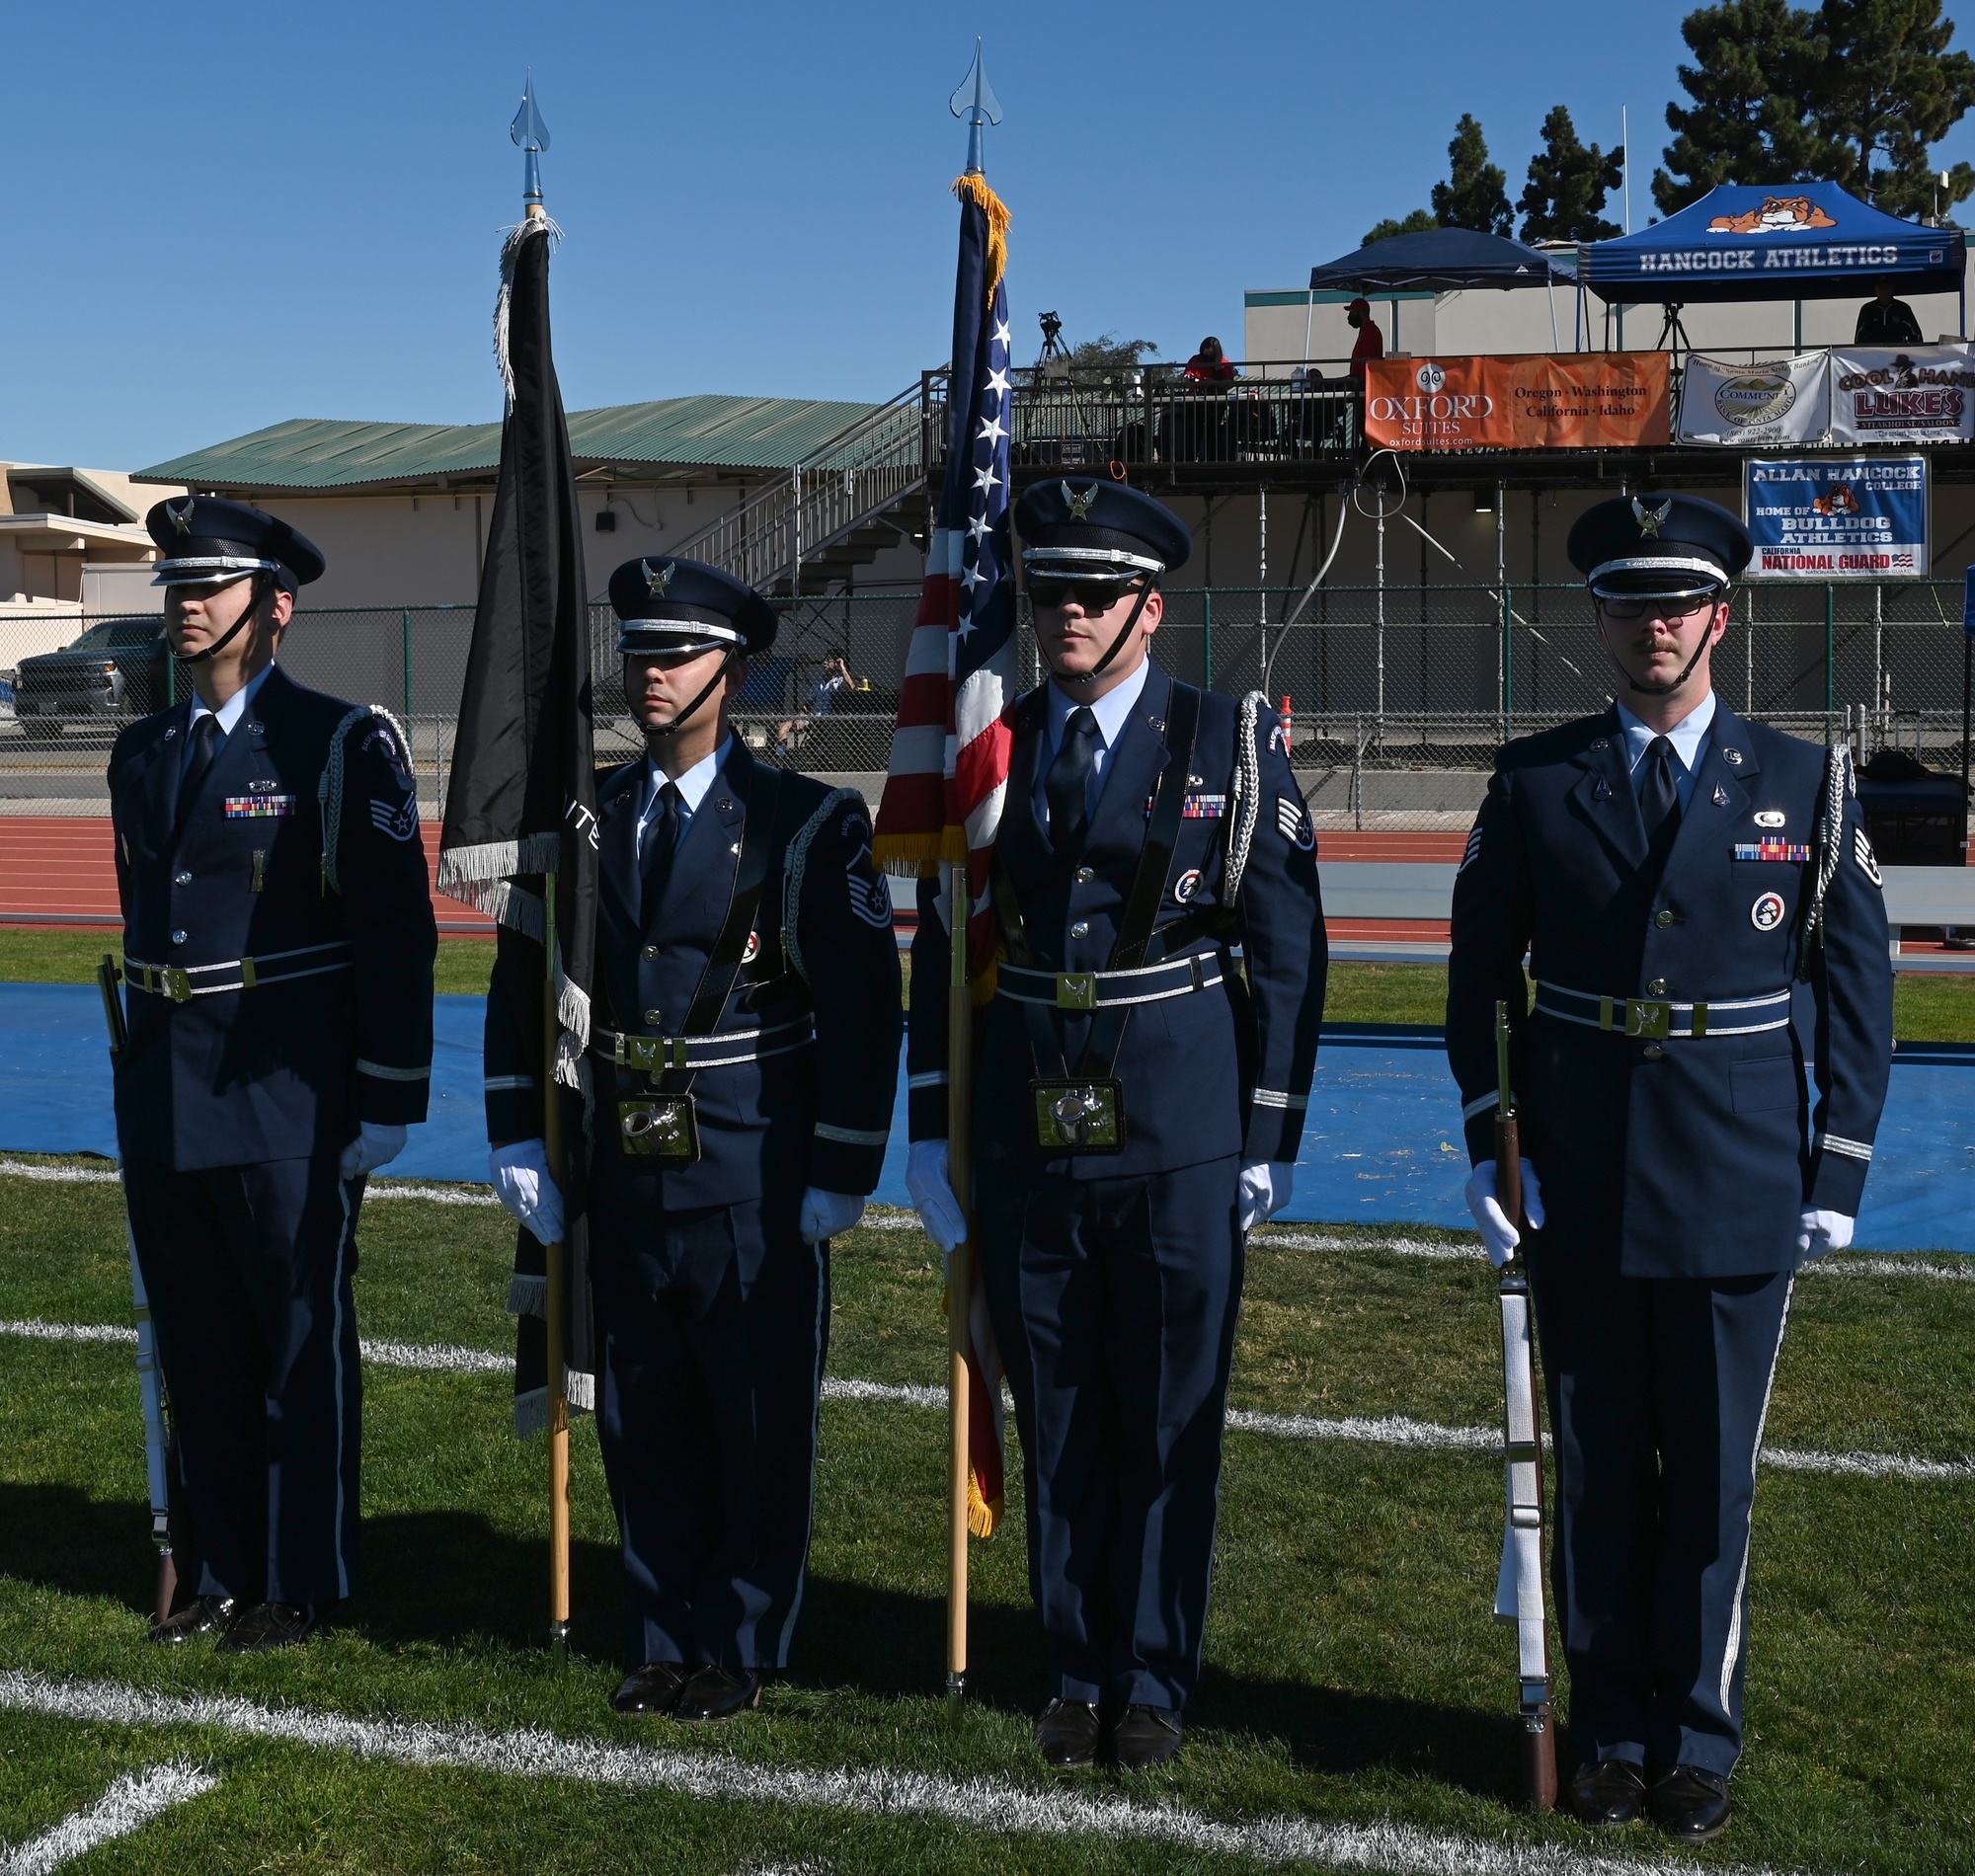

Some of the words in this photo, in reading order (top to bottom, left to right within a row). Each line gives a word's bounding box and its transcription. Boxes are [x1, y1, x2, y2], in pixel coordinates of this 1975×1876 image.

[1639, 250, 1755, 272] HANCOCK
[1763, 246, 1898, 269] ATHLETICS
[1839, 367, 1894, 391] COOL
[1515, 386, 1562, 401] Oregon
[1571, 385, 1647, 400] Washington
[1720, 385, 1791, 400] COMMUNIY
[1370, 394, 1494, 421] OXFORD
[1748, 415, 1772, 425] NTA
[1775, 396, 1794, 418] MARIA
[1855, 388, 1964, 418] LUKE'S
[1527, 405, 1589, 418] California
[1600, 404, 1635, 416] Idaho
[1402, 422, 1461, 434] SUITES
[1747, 427, 1781, 435] 922-2900
[1861, 419, 1955, 429] STEAKHOUSE/SALOON
[1389, 436, 1472, 446] oxfordsuites.com
[1753, 468, 1821, 482] ALLAN
[1827, 466, 1921, 482] HANCOCK
[1865, 481, 1922, 491] COLLEGE
[1756, 507, 1791, 516] HOME
[1793, 507, 1810, 515] OF
[1781, 516, 1891, 531] BULLDOG
[1779, 531, 1893, 544] ATHLETICS
[1762, 555, 1835, 570] NATIONAL
[1839, 554, 1890, 570] GUARD
